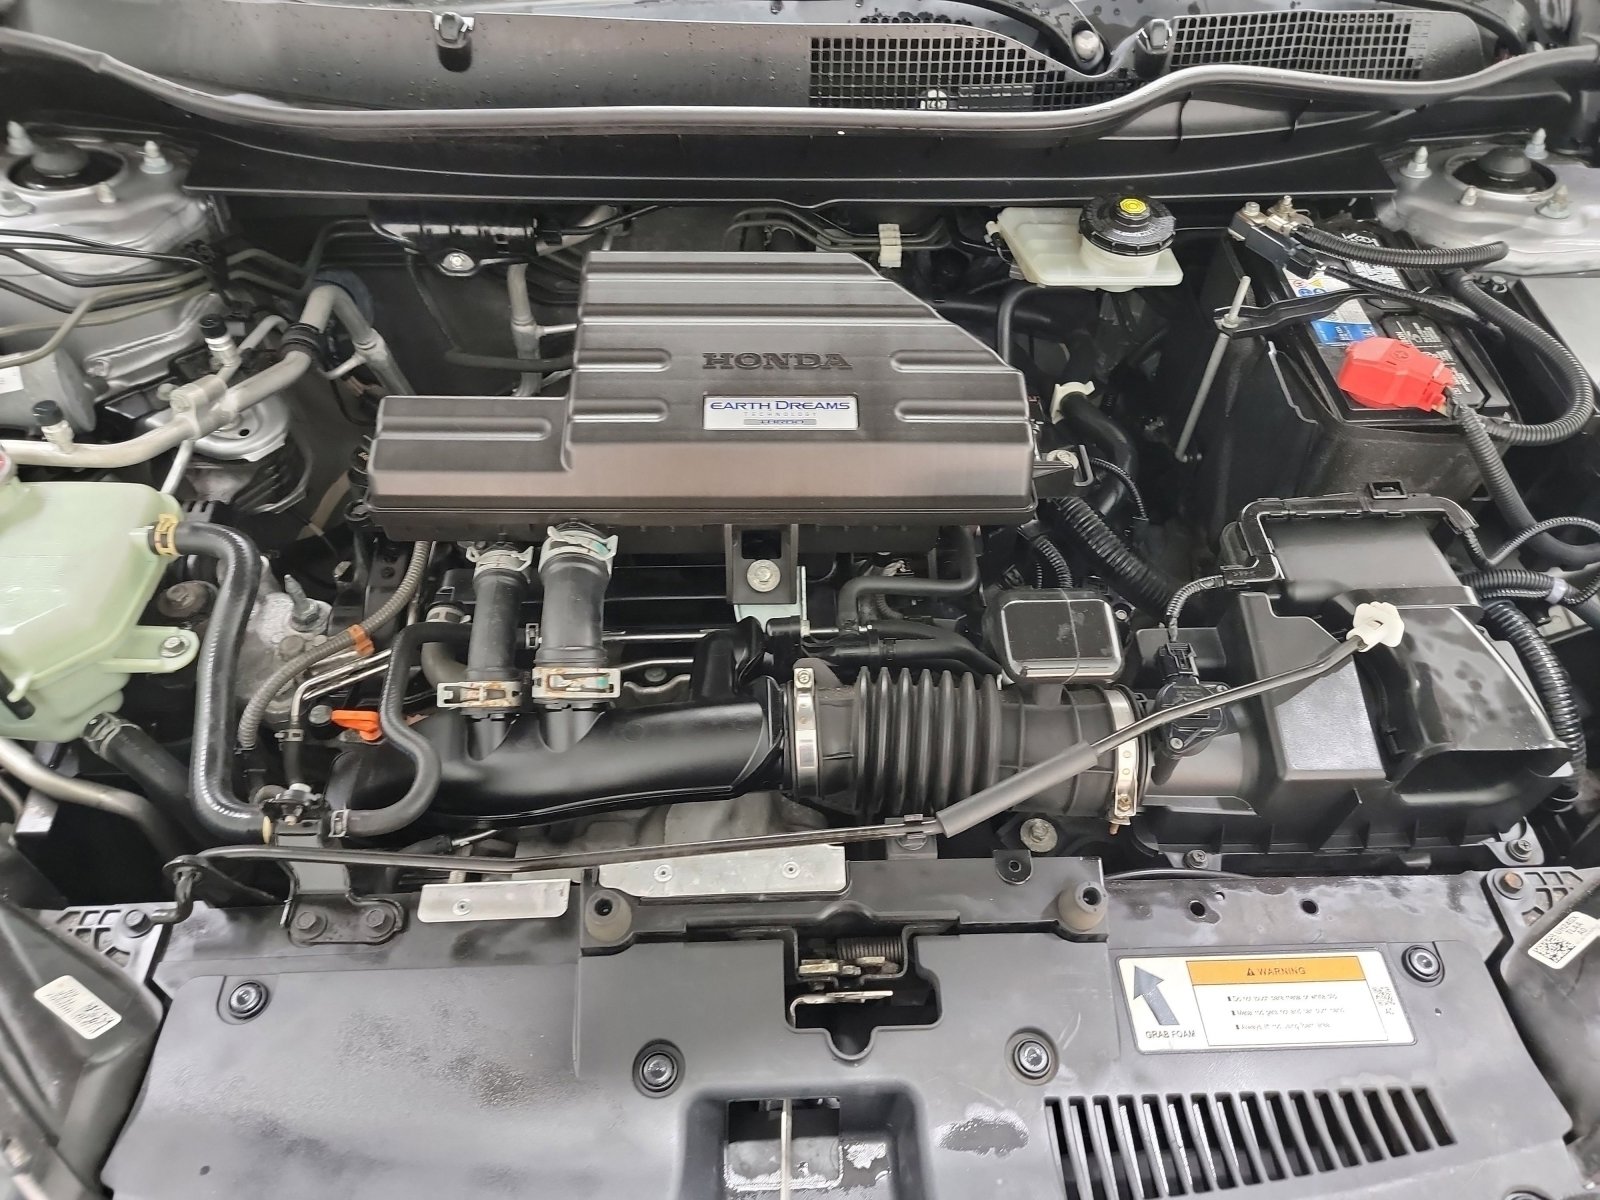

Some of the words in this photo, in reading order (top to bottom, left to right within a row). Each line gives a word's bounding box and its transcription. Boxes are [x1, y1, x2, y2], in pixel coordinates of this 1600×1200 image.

[702, 352, 853, 370] HONDA
[710, 402, 771, 410] EARTH
[775, 400, 850, 410] DREAMS
[1258, 966, 1306, 976] WARNING
[1145, 1030, 1170, 1039] GRAB
[1171, 1029, 1196, 1038] FOAM
